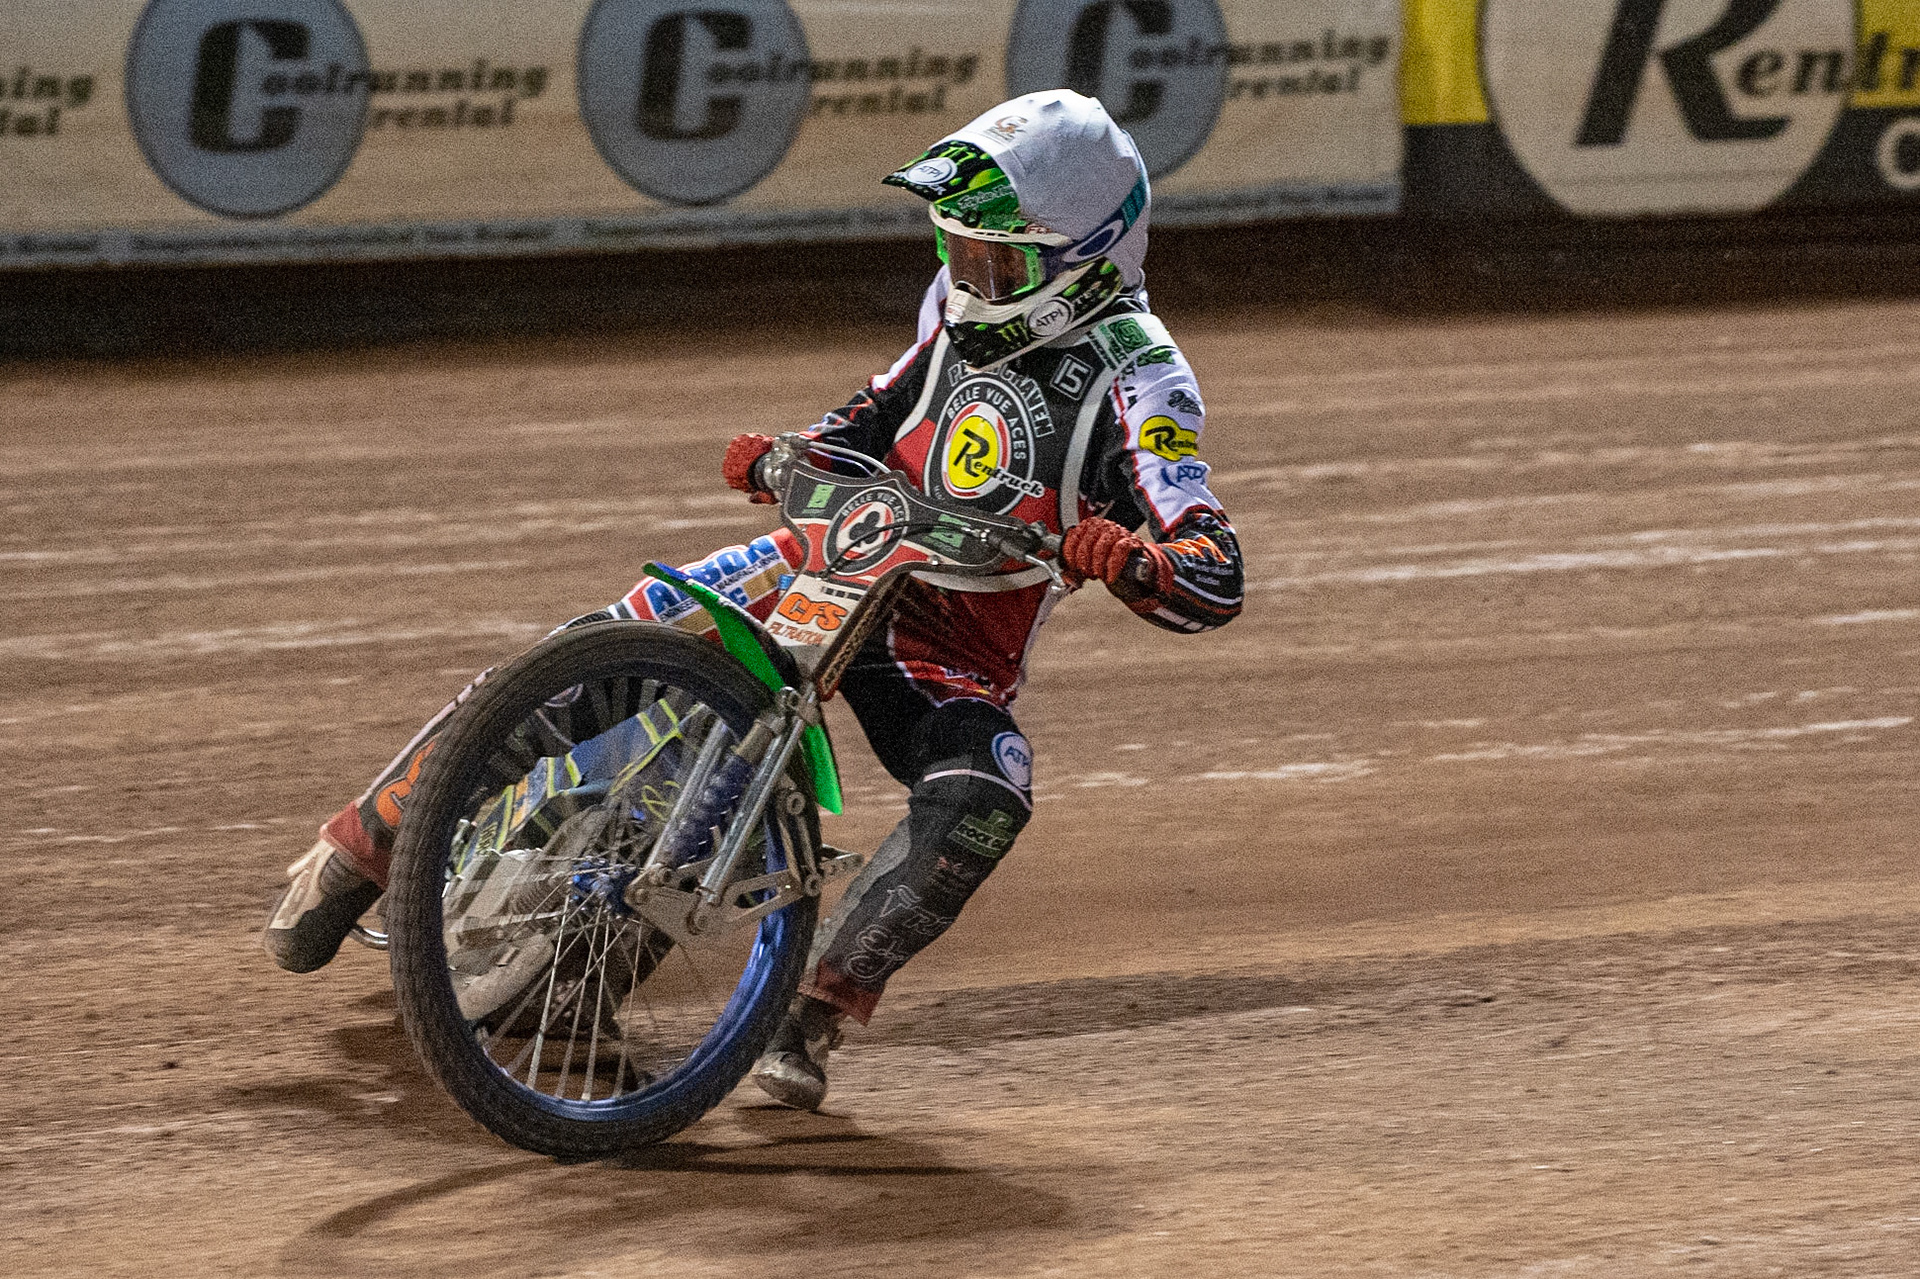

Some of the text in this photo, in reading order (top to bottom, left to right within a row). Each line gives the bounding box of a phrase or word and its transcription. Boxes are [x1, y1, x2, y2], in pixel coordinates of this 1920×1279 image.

[1036, 308, 1064, 327] ATPI
[947, 386, 1027, 460] BELLE VUE ACES
[953, 428, 1044, 497] Rentruck
[777, 592, 849, 631] CFS
